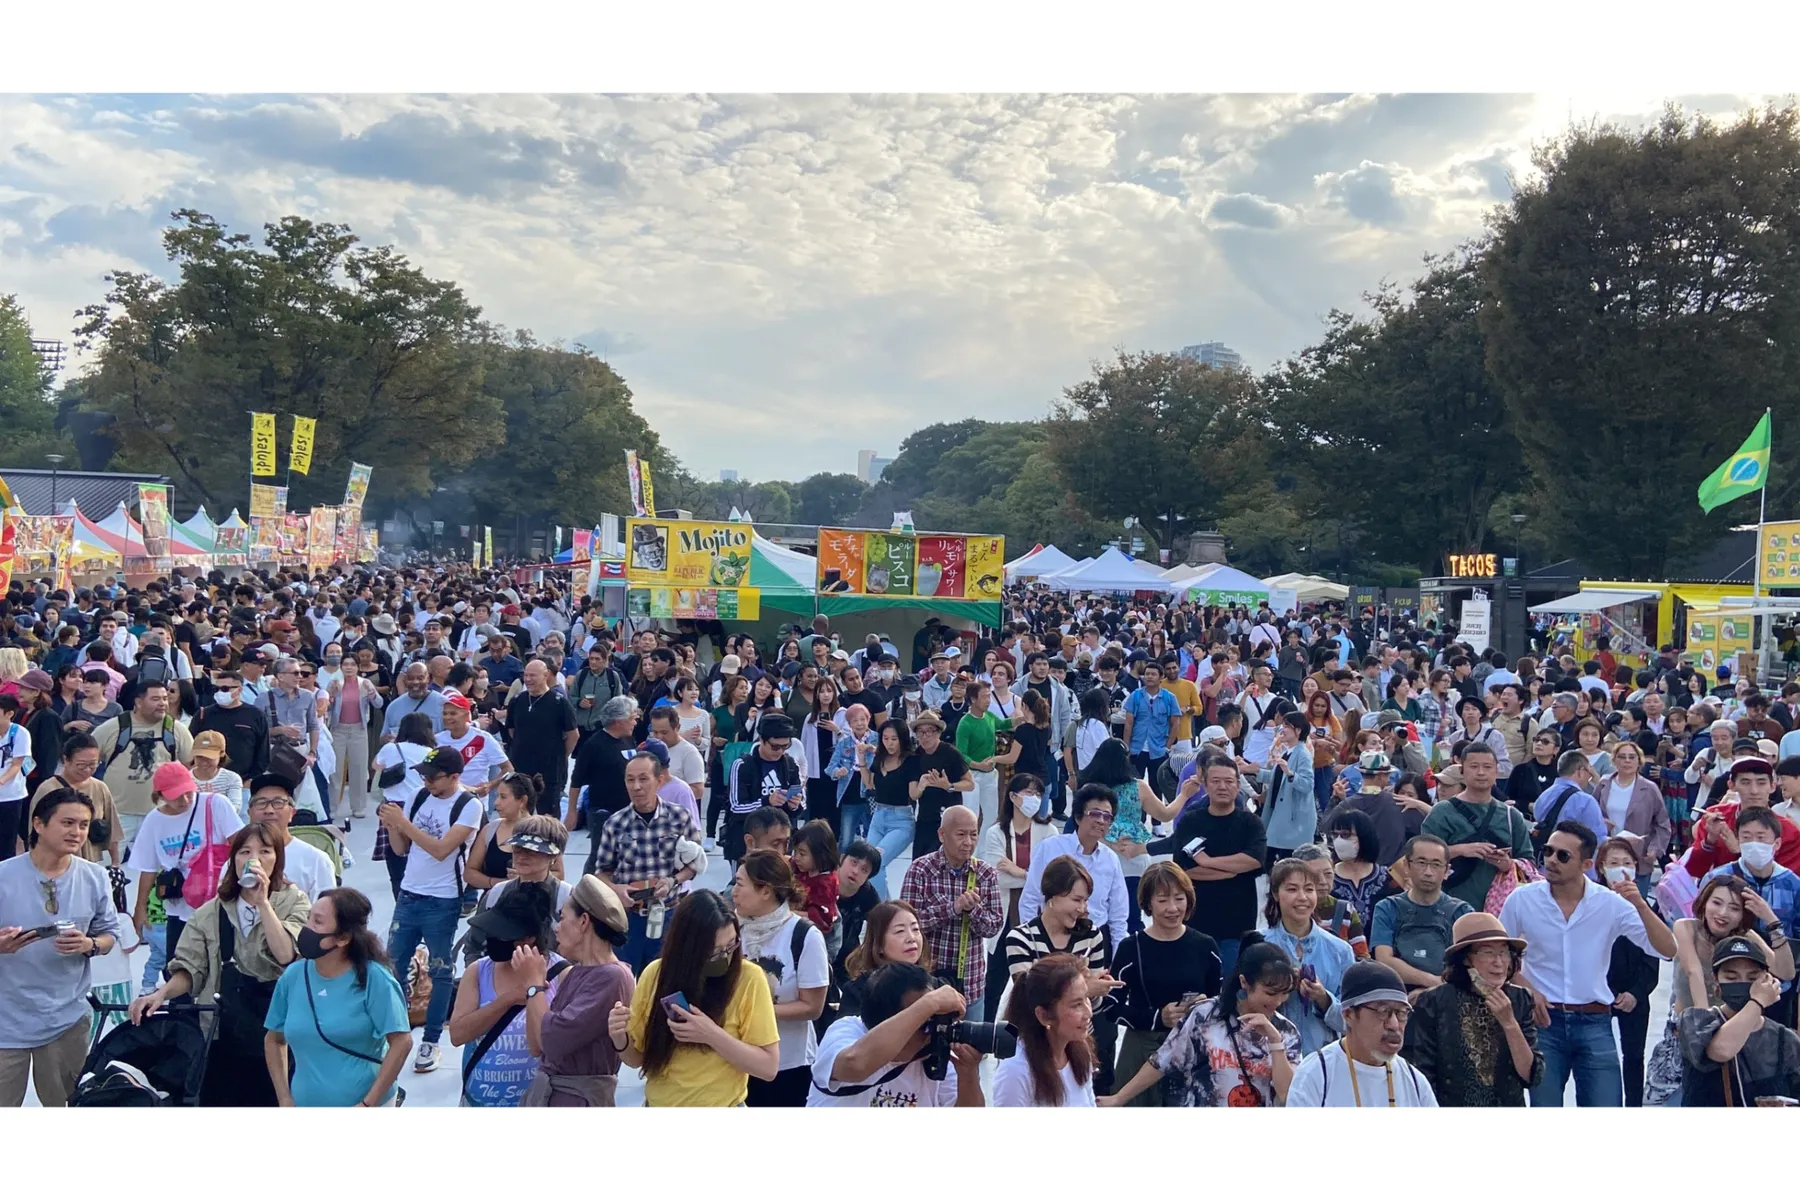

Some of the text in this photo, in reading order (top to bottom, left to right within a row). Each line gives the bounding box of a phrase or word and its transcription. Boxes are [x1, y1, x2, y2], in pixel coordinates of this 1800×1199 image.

[678, 528, 747, 557] Mojito
[829, 540, 857, 580] モラーダ
[888, 543, 910, 588] ピスコ
[1449, 553, 1497, 577] TACOS
[1218, 592, 1253, 604] Smiles
[494, 1053, 529, 1066] Bloom
[484, 1069, 522, 1083] BRIGHT
[479, 1083, 500, 1098] The
